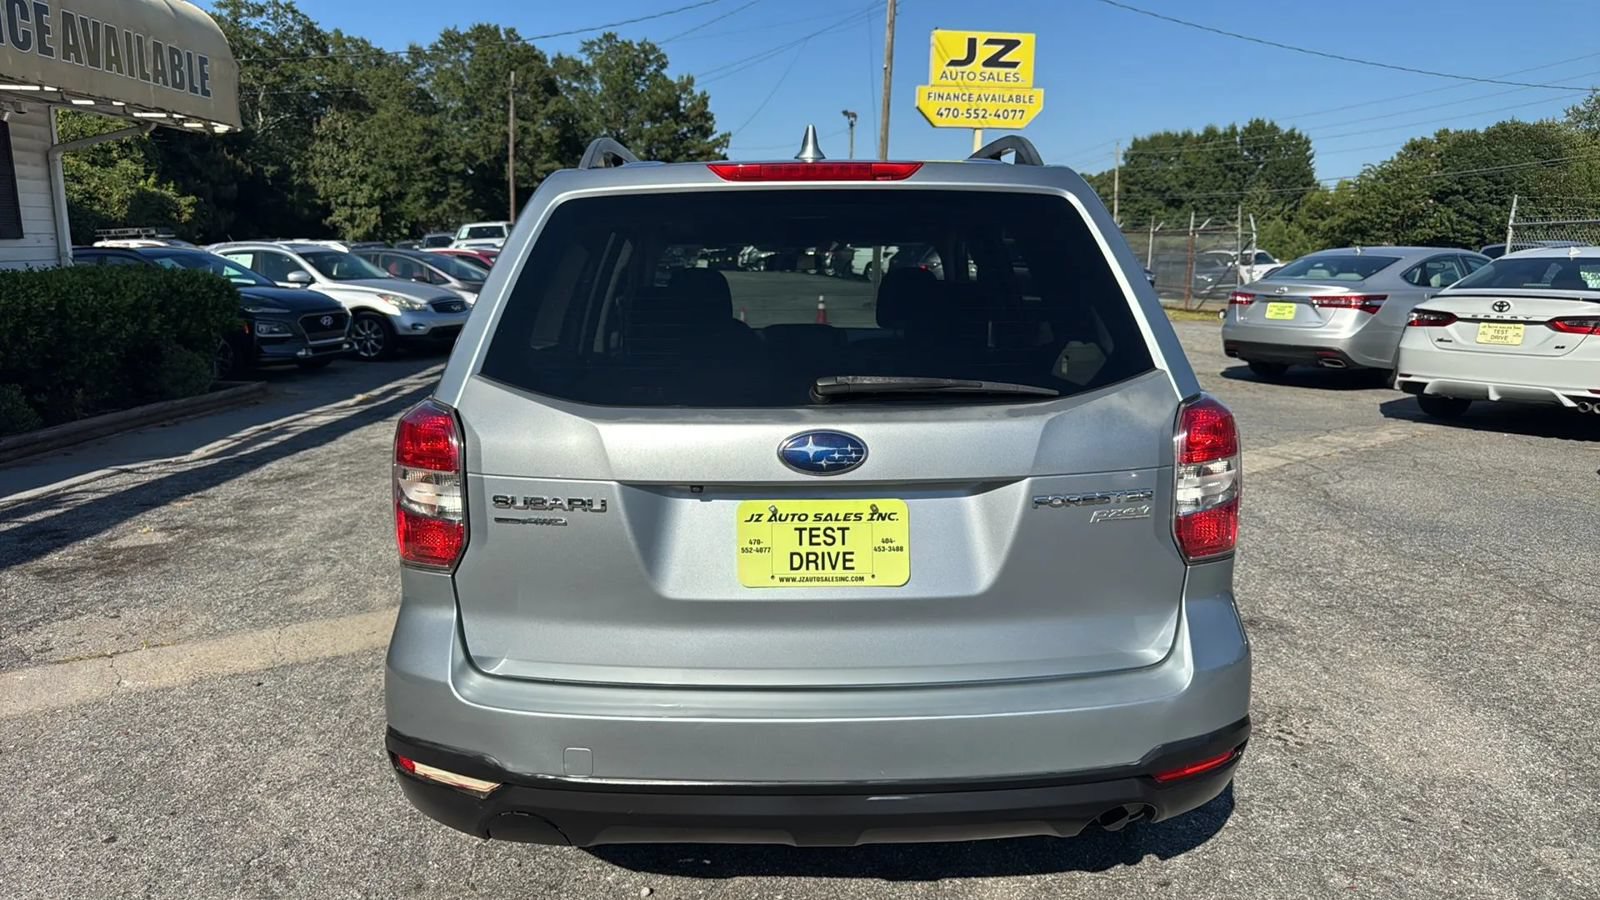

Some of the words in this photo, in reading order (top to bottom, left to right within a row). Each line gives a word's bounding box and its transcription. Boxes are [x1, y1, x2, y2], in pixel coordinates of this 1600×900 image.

[0, 0, 56, 60] CE
[60, 8, 212, 98] AVAILABLE
[945, 37, 1022, 69] JZ
[940, 71, 977, 82] AUTO
[979, 72, 1020, 83] SALES
[927, 92, 974, 103] FINANCE
[976, 94, 1035, 104] AVAILABLE
[936, 107, 1025, 120] 470-552-4077
[492, 494, 608, 513] SUBARU
[1032, 488, 1153, 509] FORESTER
[744, 513, 763, 523] JZ
[767, 512, 808, 522] AUTO
[812, 512, 863, 522] SALES
[867, 512, 899, 522] INC.
[794, 527, 850, 546] TEST
[789, 551, 855, 571] DRIVE
